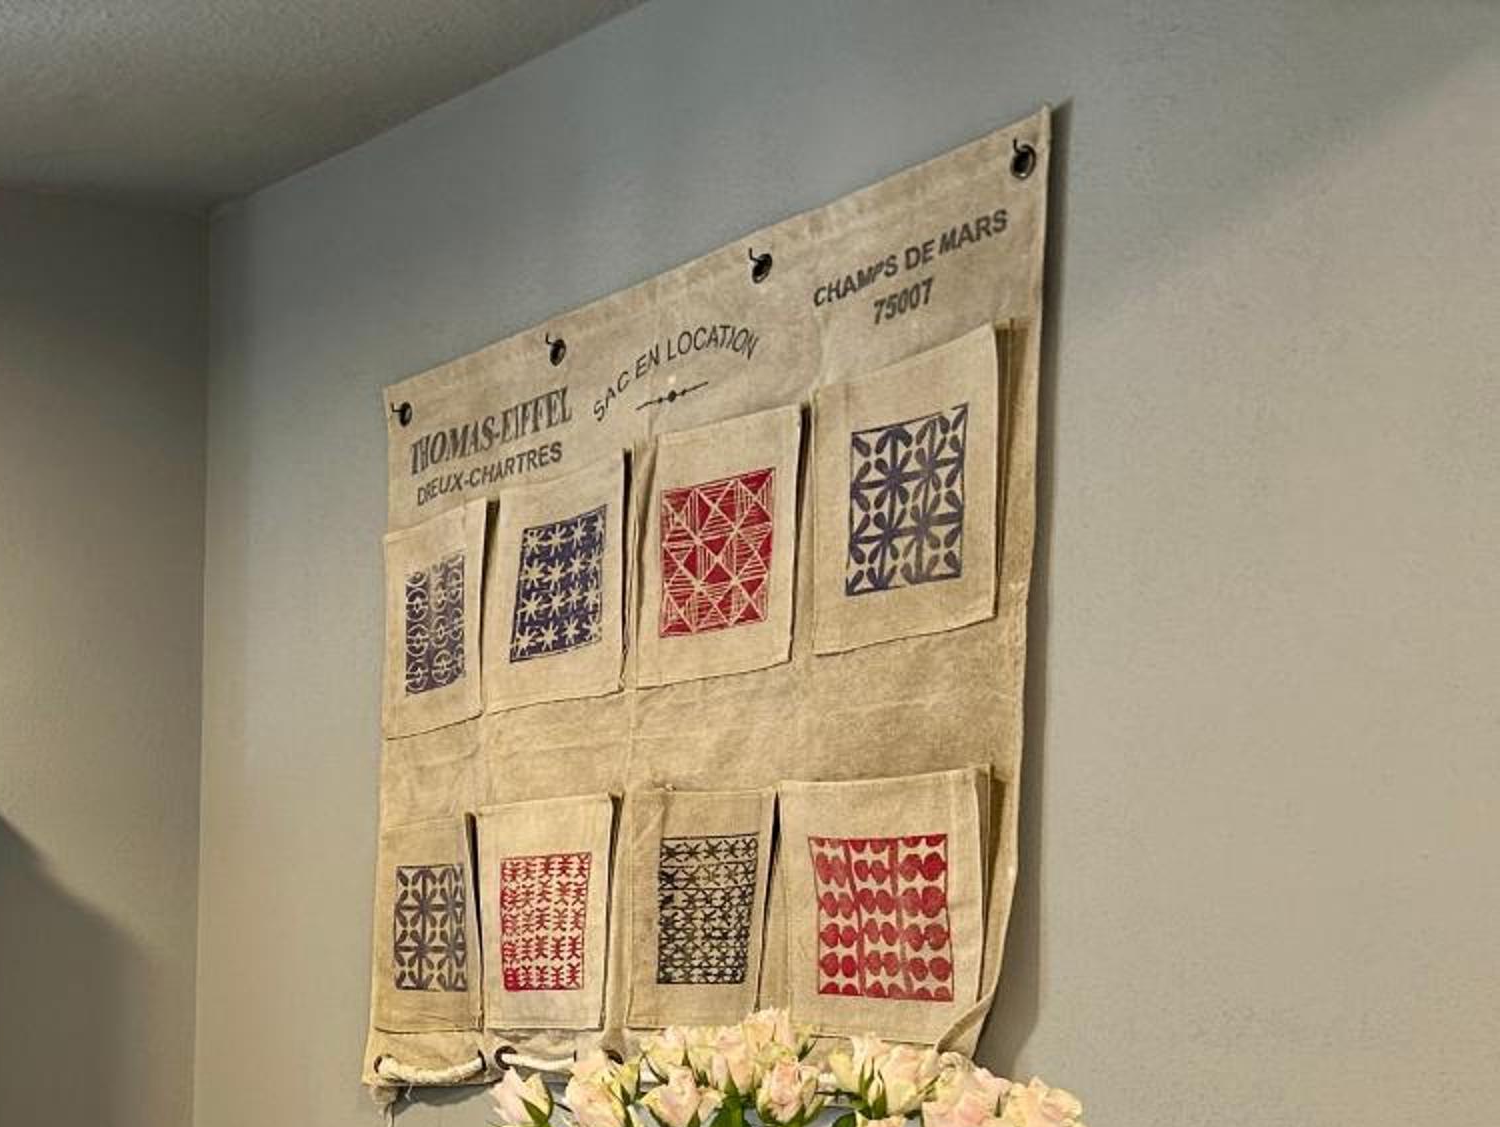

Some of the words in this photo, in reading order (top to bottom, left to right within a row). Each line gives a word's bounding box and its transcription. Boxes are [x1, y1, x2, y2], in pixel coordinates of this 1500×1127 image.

[814, 254, 899, 308] CHAMPS
[904, 239, 936, 271] DE
[938, 209, 1008, 256] MARS
[873, 276, 934, 320] 75007
[593, 370, 631, 423] SAC
[635, 343, 660, 379] EN
[666, 325, 760, 361] LOCATION
